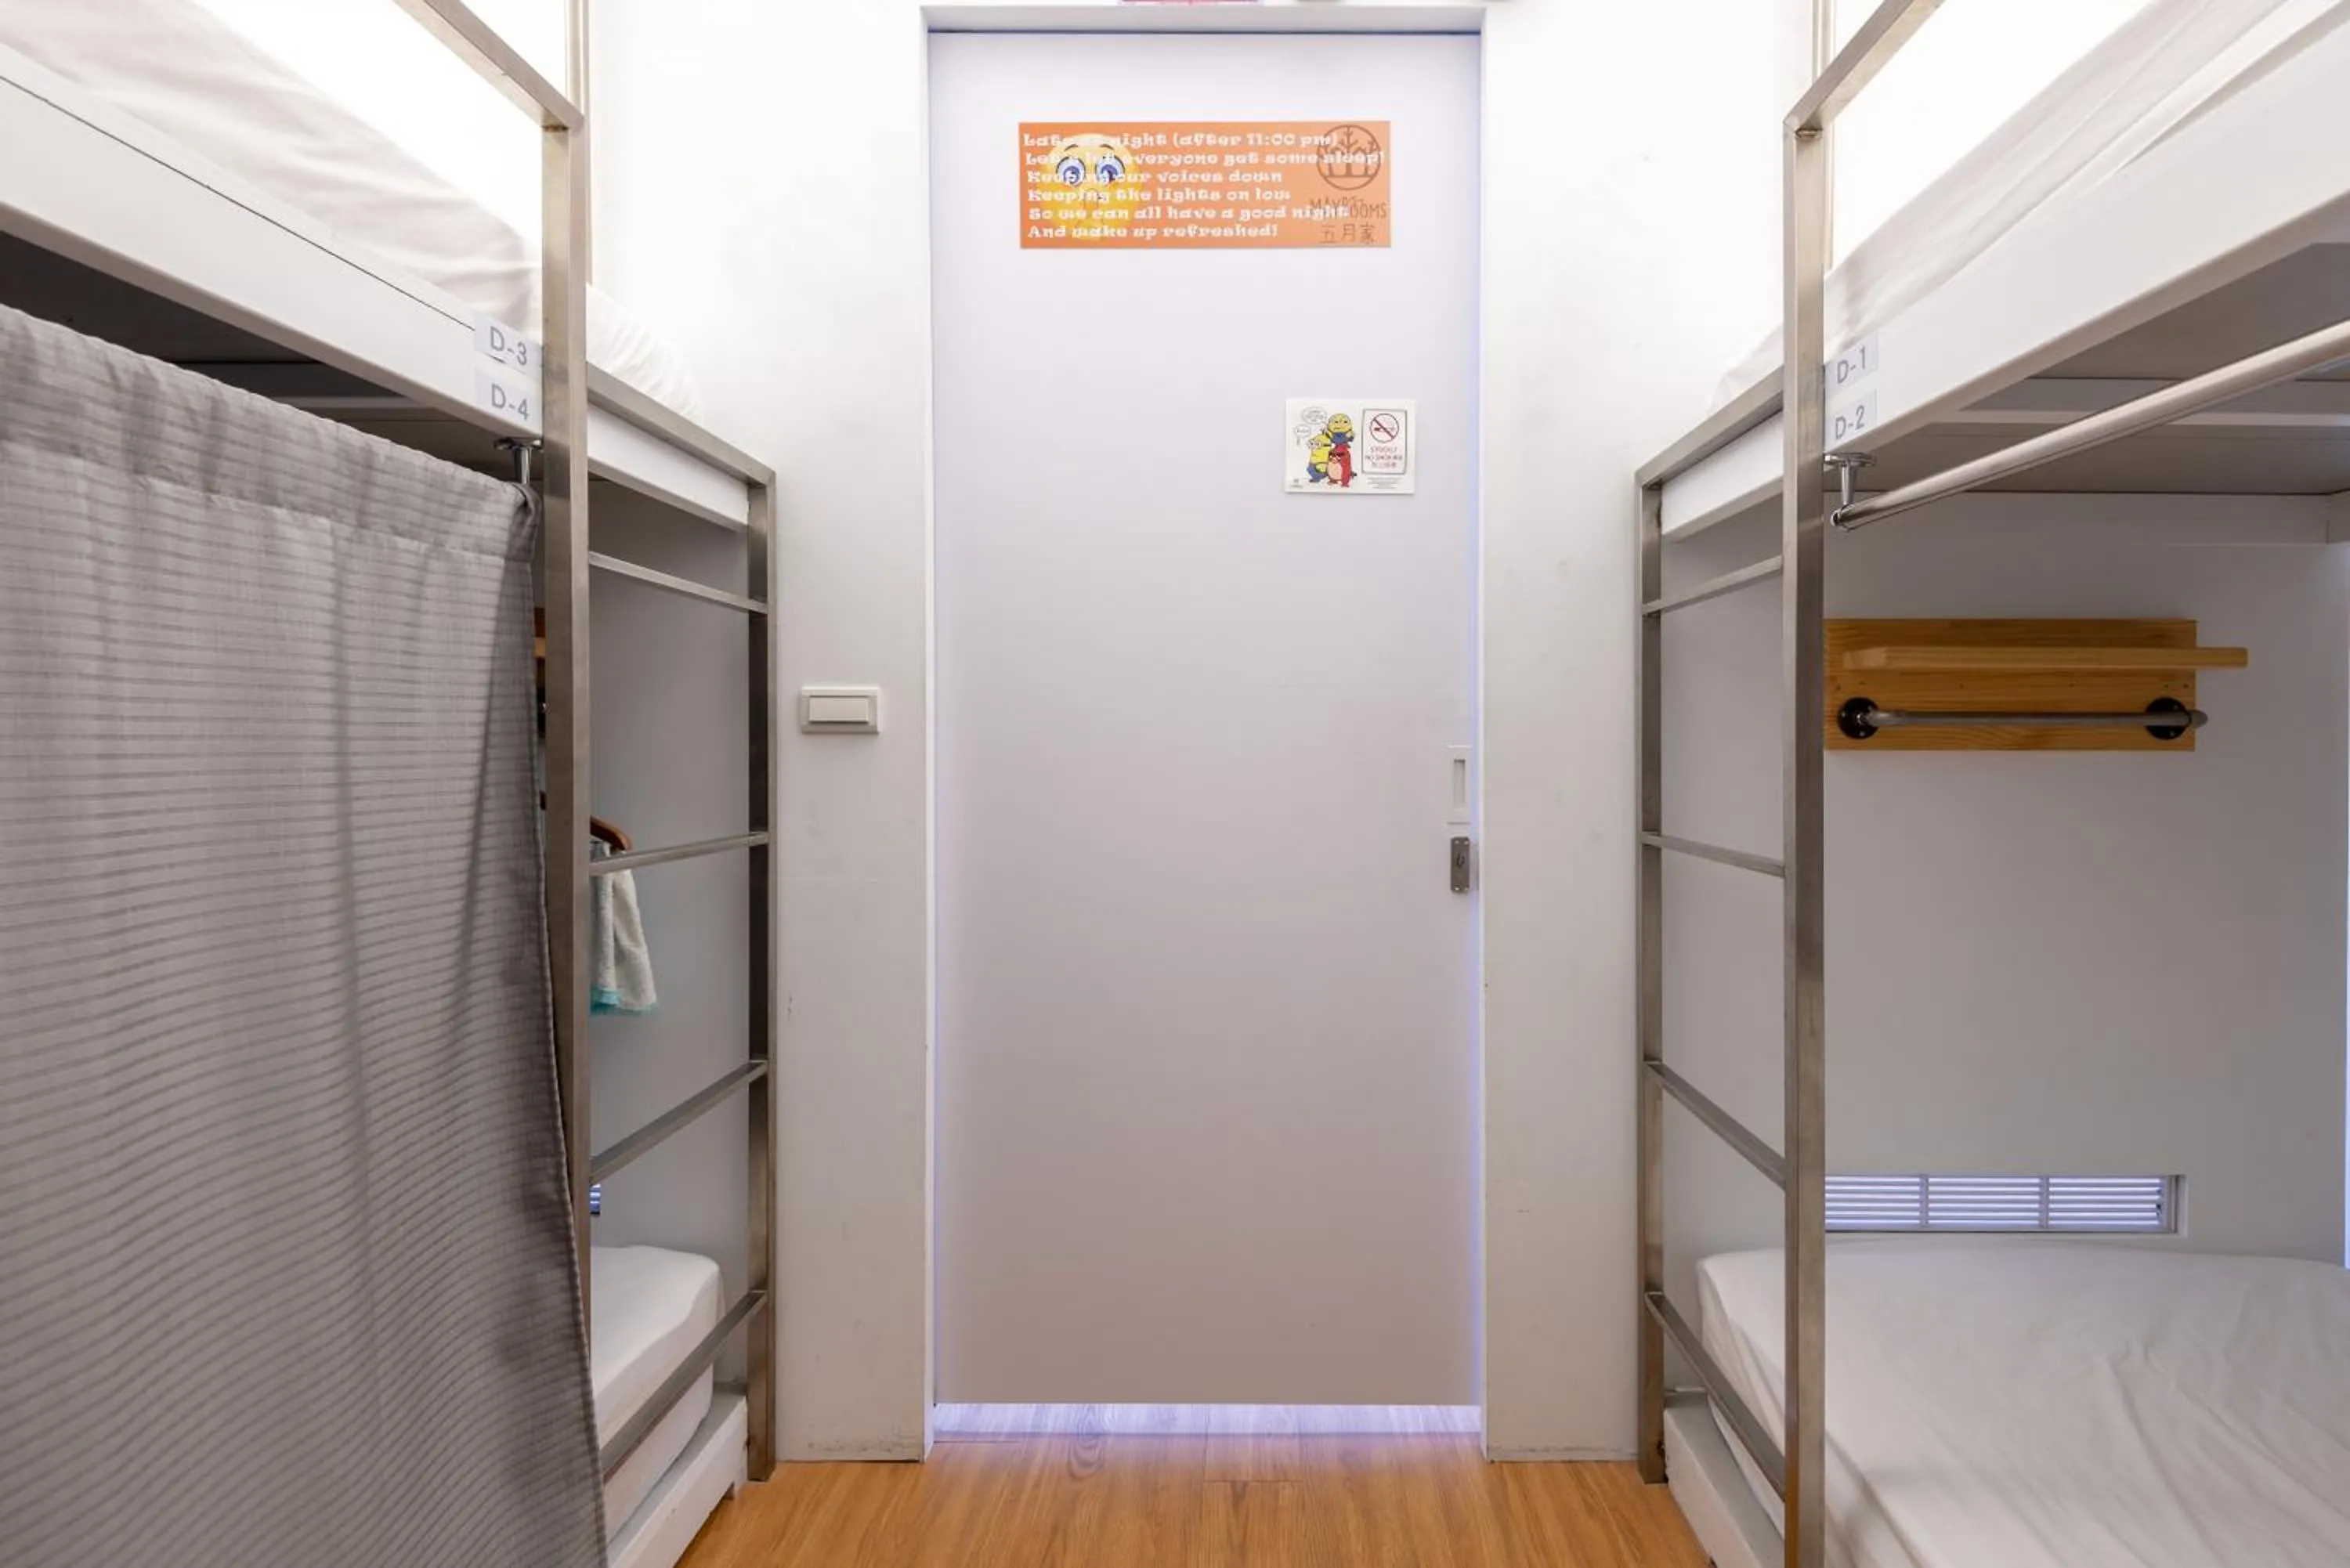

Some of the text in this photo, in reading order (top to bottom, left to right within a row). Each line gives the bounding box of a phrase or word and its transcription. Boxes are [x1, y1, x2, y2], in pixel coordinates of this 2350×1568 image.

[1173, 132, 1242, 148] (after
[1246, 132, 1295, 146] 11:00
[1300, 132, 1338, 147] pm)
[1122, 153, 1218, 166] everyone
[1224, 151, 1259, 167] get
[1264, 152, 1318, 164] some
[1323, 150, 1384, 165] sleep!
[1158, 170, 1224, 182] voices
[1228, 169, 1282, 182] down
[1027, 187, 1291, 204] Keeping the lights on low
[1028, 208, 1053, 220] So
[1058, 209, 1087, 219] we
[1091, 208, 1129, 220] can
[1134, 206, 1161, 219] all
[1167, 206, 1217, 220] have
[1221, 208, 1235, 219] a
[1240, 205, 1286, 222] good
[1028, 225, 1066, 238] And
[1133, 226, 1158, 240] up
[1162, 223, 1278, 239] refreshed!
[490, 325, 528, 367] D-3
[1837, 345, 1866, 384] D-1
[491, 382, 530, 421] D-4
[1835, 404, 1865, 440] D-2
